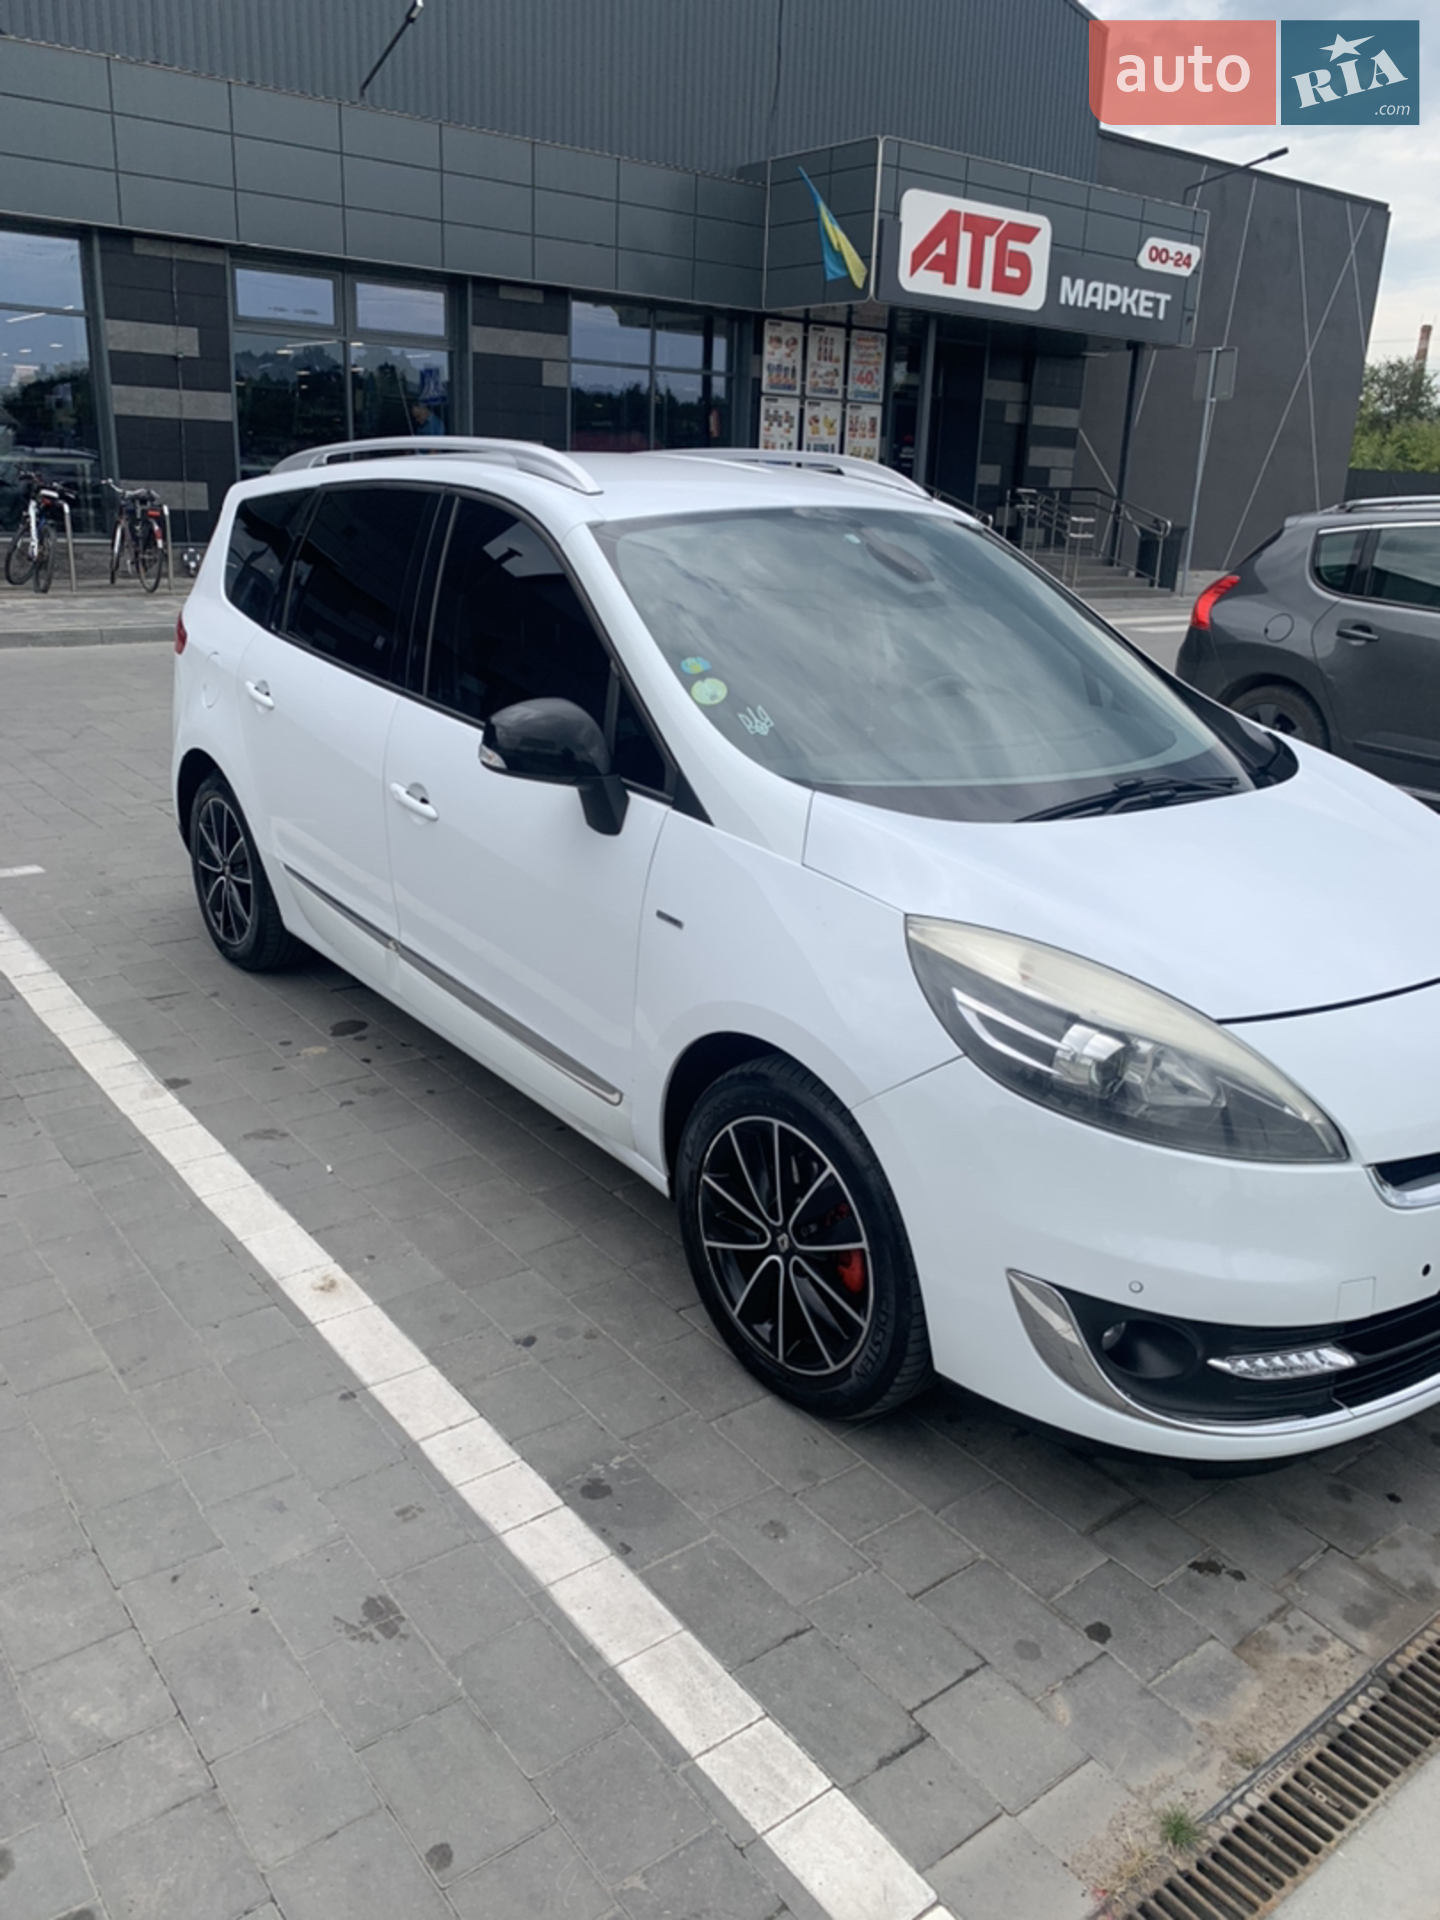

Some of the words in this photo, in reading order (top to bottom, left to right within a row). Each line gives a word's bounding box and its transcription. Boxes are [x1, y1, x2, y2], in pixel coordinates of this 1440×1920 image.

[909, 208, 1042, 296] АТБ
[1148, 245, 1192, 270] 00-24
[1059, 276, 1172, 320] МАРКЕТ
